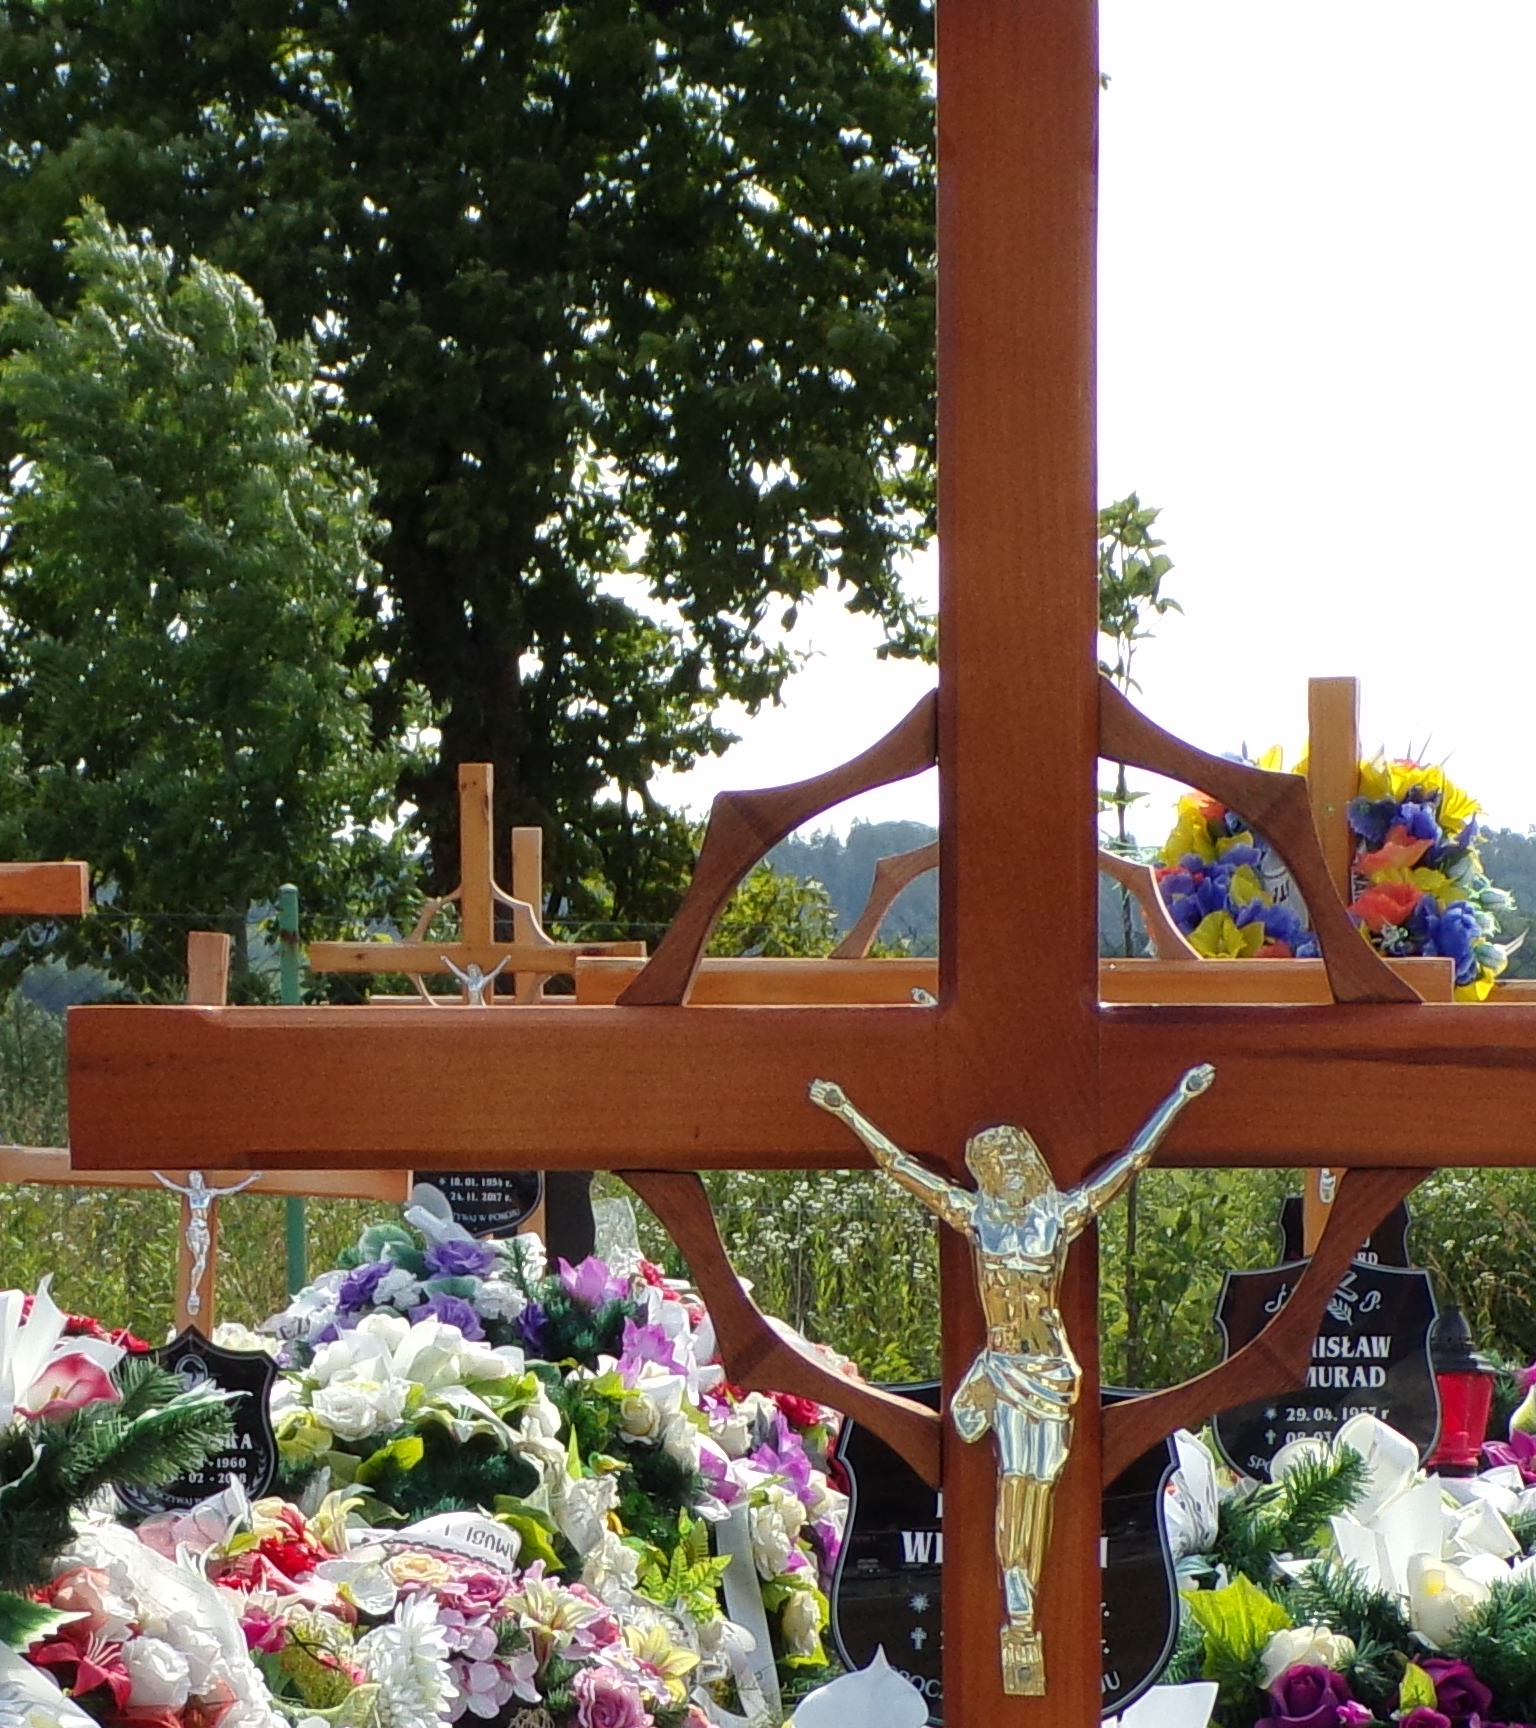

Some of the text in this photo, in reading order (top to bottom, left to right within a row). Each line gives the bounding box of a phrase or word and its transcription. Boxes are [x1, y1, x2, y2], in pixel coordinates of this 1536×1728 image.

[1359, 1290, 1382, 1313] P.
[217, 1457, 247, 1469] 1960
[217, 1473, 247, 1484] 208
